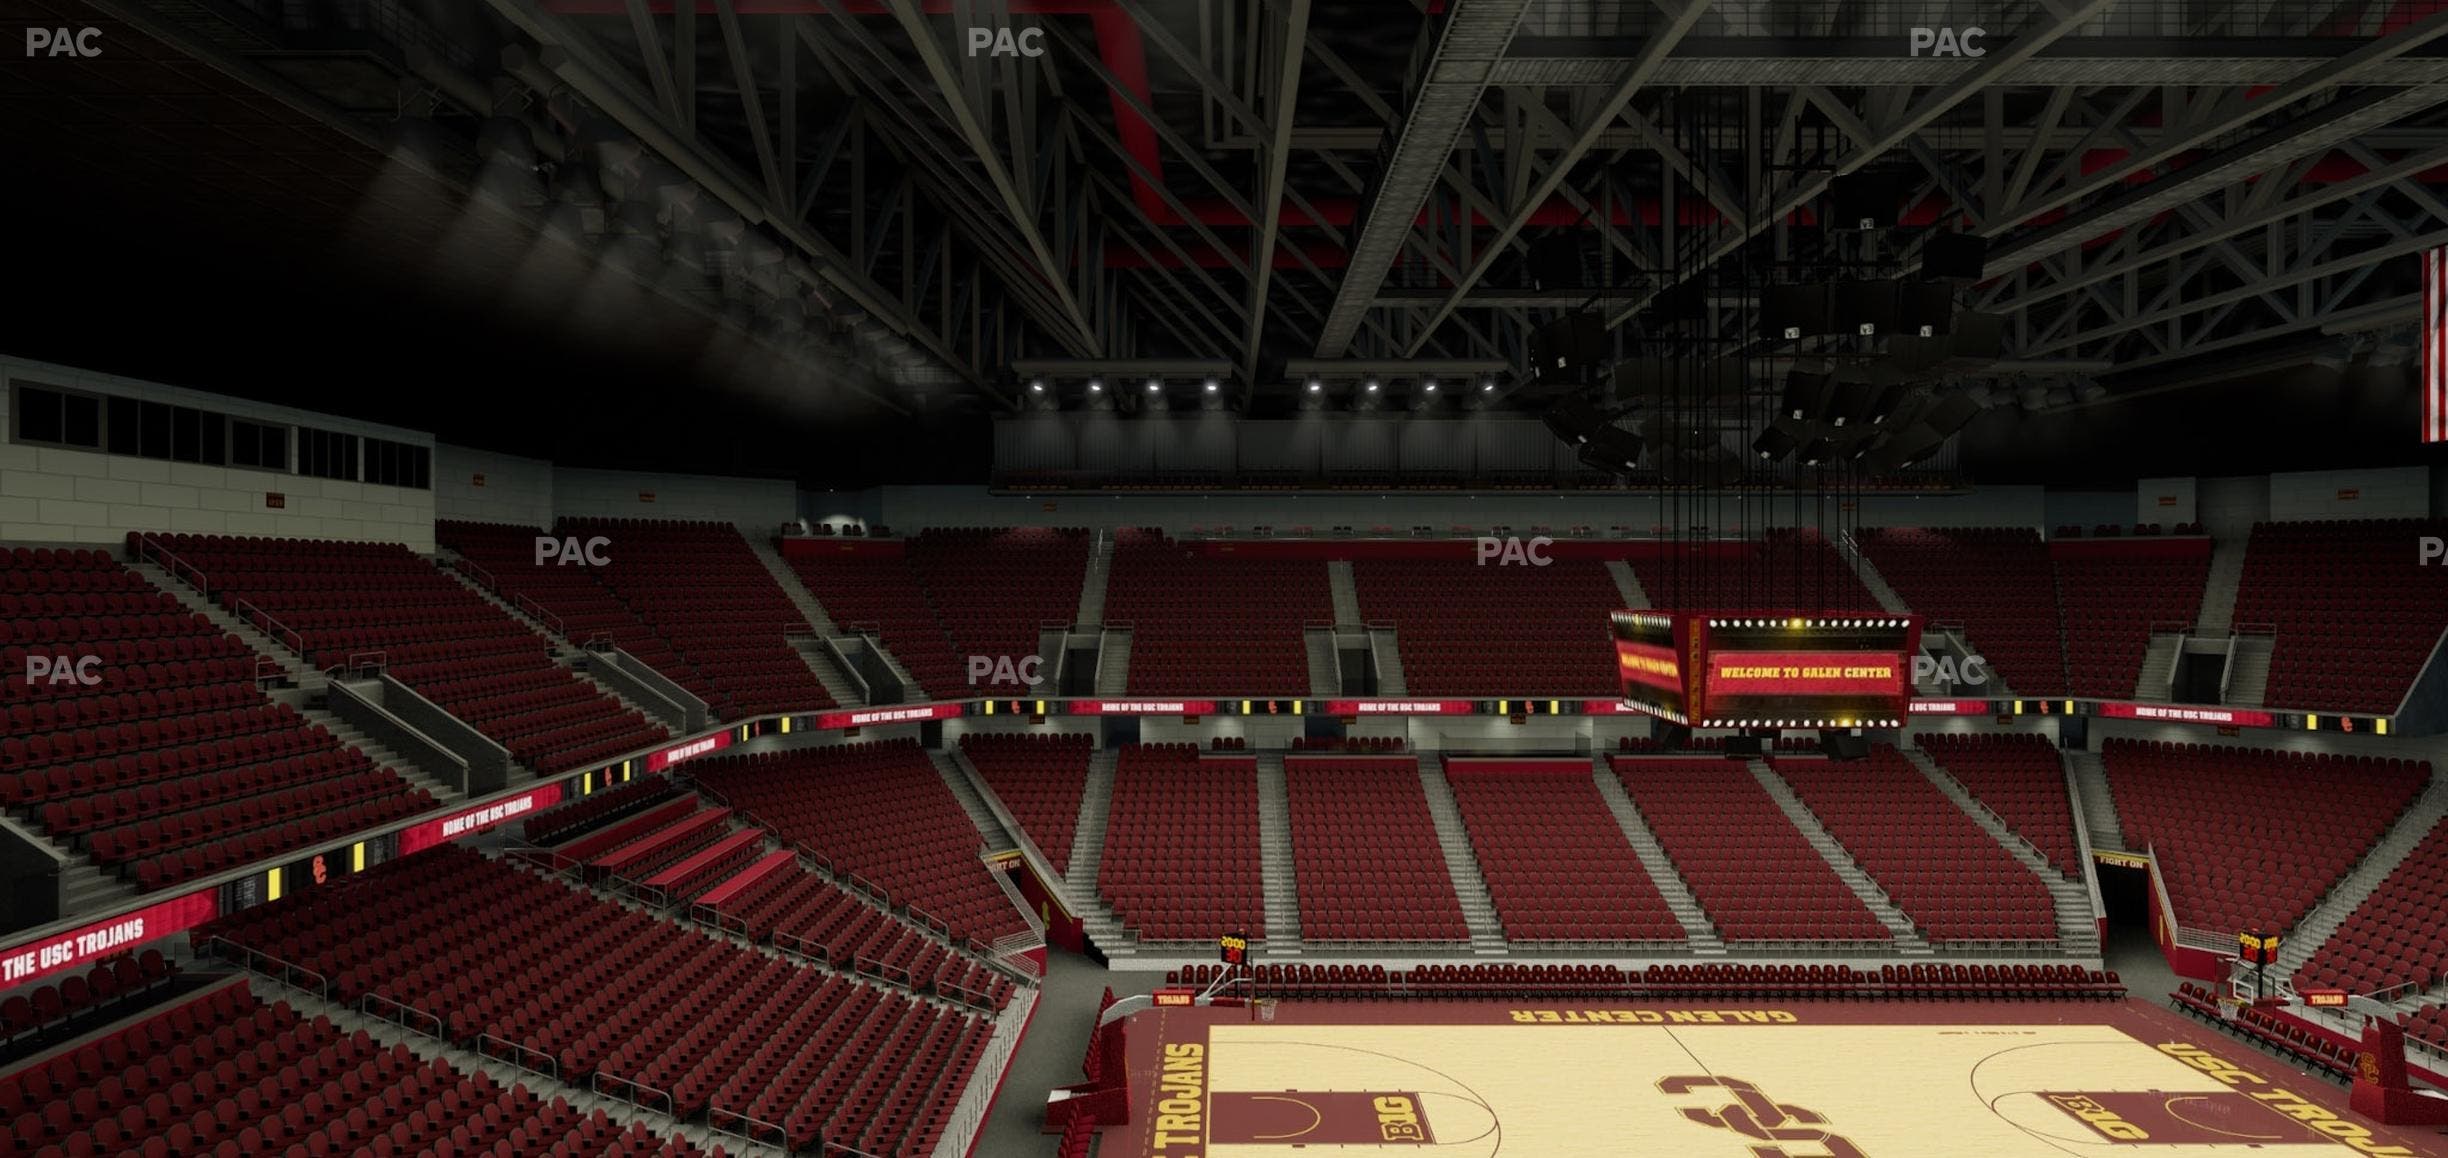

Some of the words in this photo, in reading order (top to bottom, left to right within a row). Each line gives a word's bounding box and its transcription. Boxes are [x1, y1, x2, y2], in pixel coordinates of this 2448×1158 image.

[1721, 667, 1781, 678] WELCOME
[1783, 667, 1800, 678] TO
[1802, 667, 1842, 678] GALEN
[1844, 667, 1892, 678] CENTER
[465, 813, 475, 829] OF
[476, 809, 490, 826] THE
[2129, 860, 2143, 869] ON
[2, 951, 36, 981] THE
[40, 940, 73, 969] USC
[76, 918, 144, 957] TROJANS
[1509, 1010, 1665, 1023] CENTER
[1666, 1010, 1798, 1023] GALEN
[2156, 1042, 2268, 1084] USC
[1153, 1043, 1205, 1149] TROJANS
